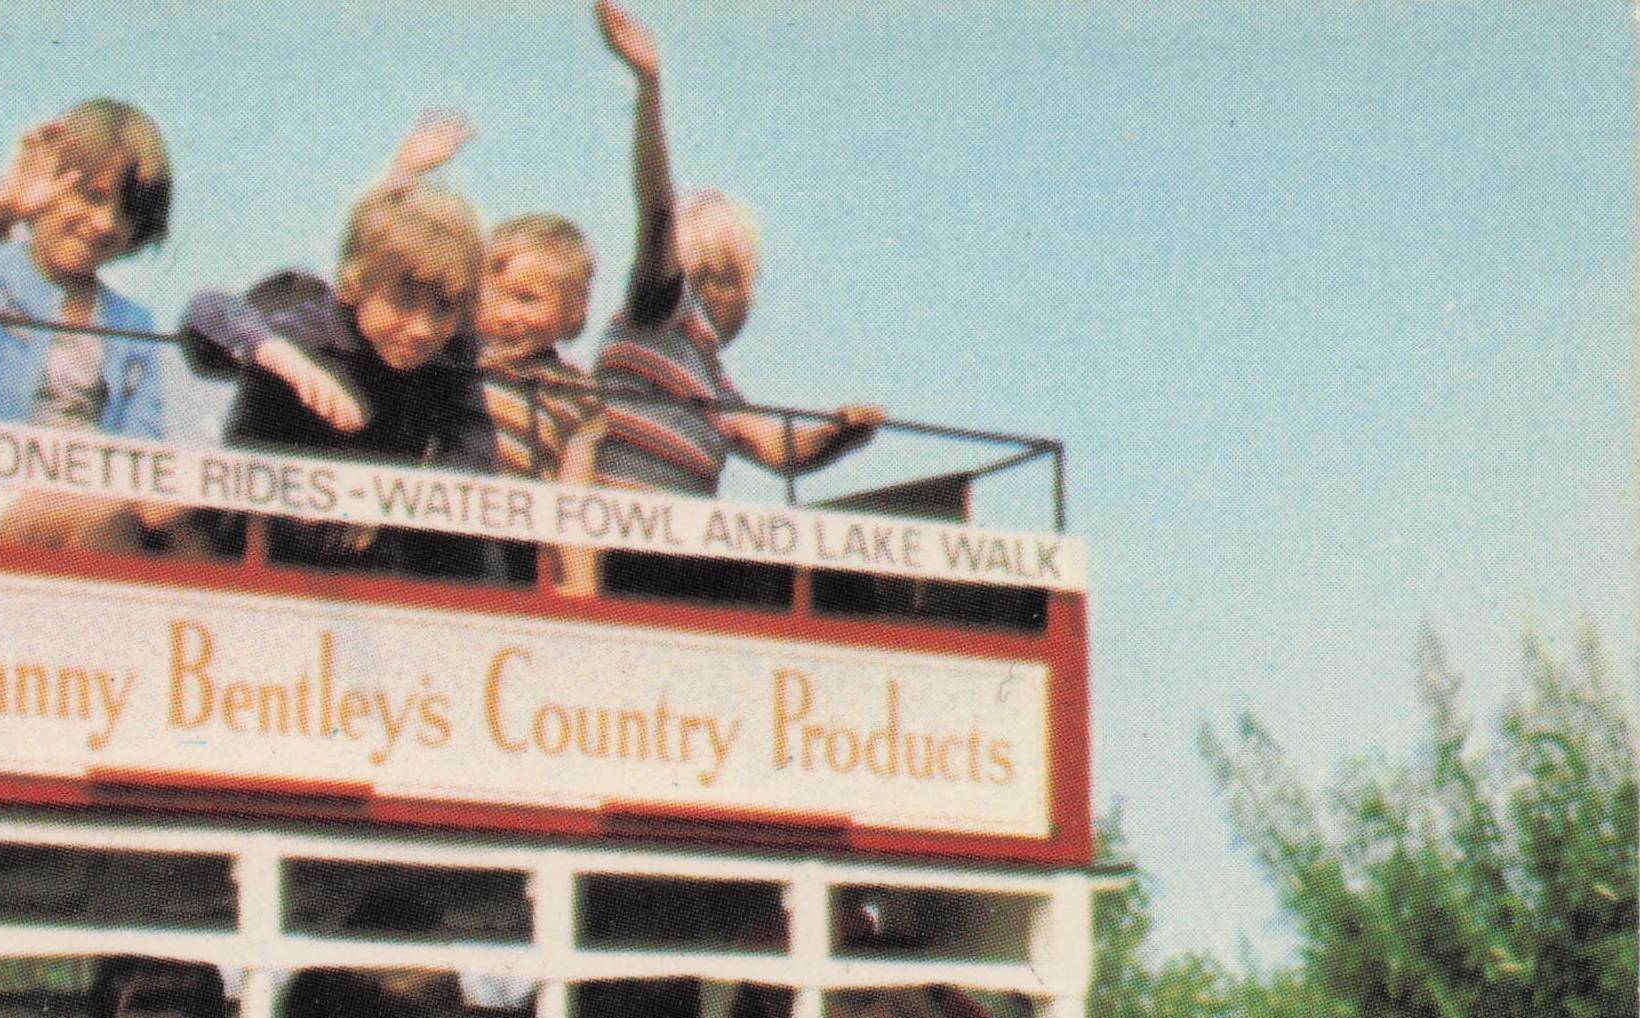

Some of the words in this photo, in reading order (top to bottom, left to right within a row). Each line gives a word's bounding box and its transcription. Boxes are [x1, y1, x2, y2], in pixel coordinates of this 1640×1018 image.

[554, 491, 690, 546] FOWL
[702, 508, 798, 558] AND
[815, 521, 923, 570] LAKE
[938, 532, 1062, 582] WALK
[166, 617, 454, 767] Bentley's
[483, 645, 742, 786] Country
[771, 667, 1016, 786] Products
